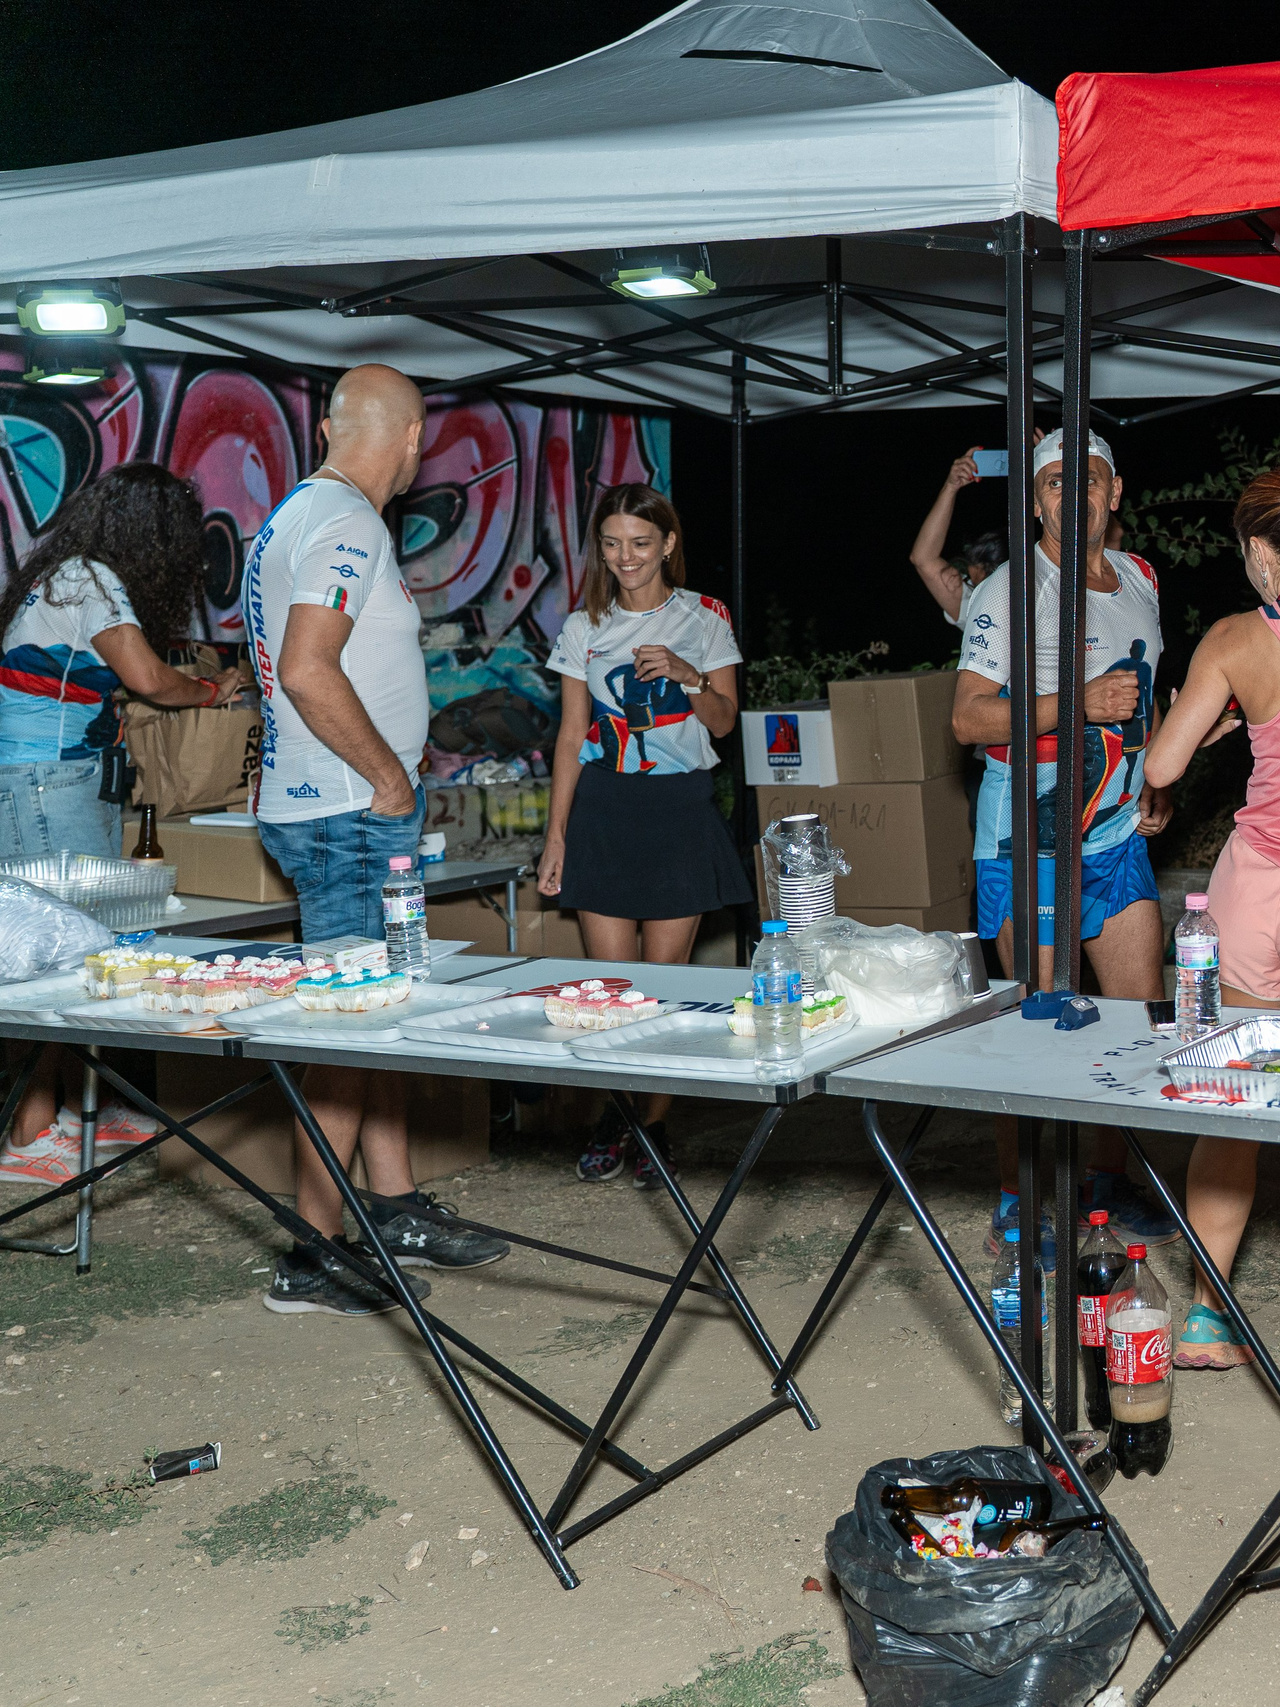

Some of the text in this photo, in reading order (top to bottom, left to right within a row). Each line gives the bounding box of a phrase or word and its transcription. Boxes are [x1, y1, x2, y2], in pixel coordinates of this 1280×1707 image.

[346, 547, 369, 559] AIGER
[251, 524, 276, 640] MATTERS
[257, 639, 273, 700] STEP
[1089, 1072, 1146, 1096] TRAIL
